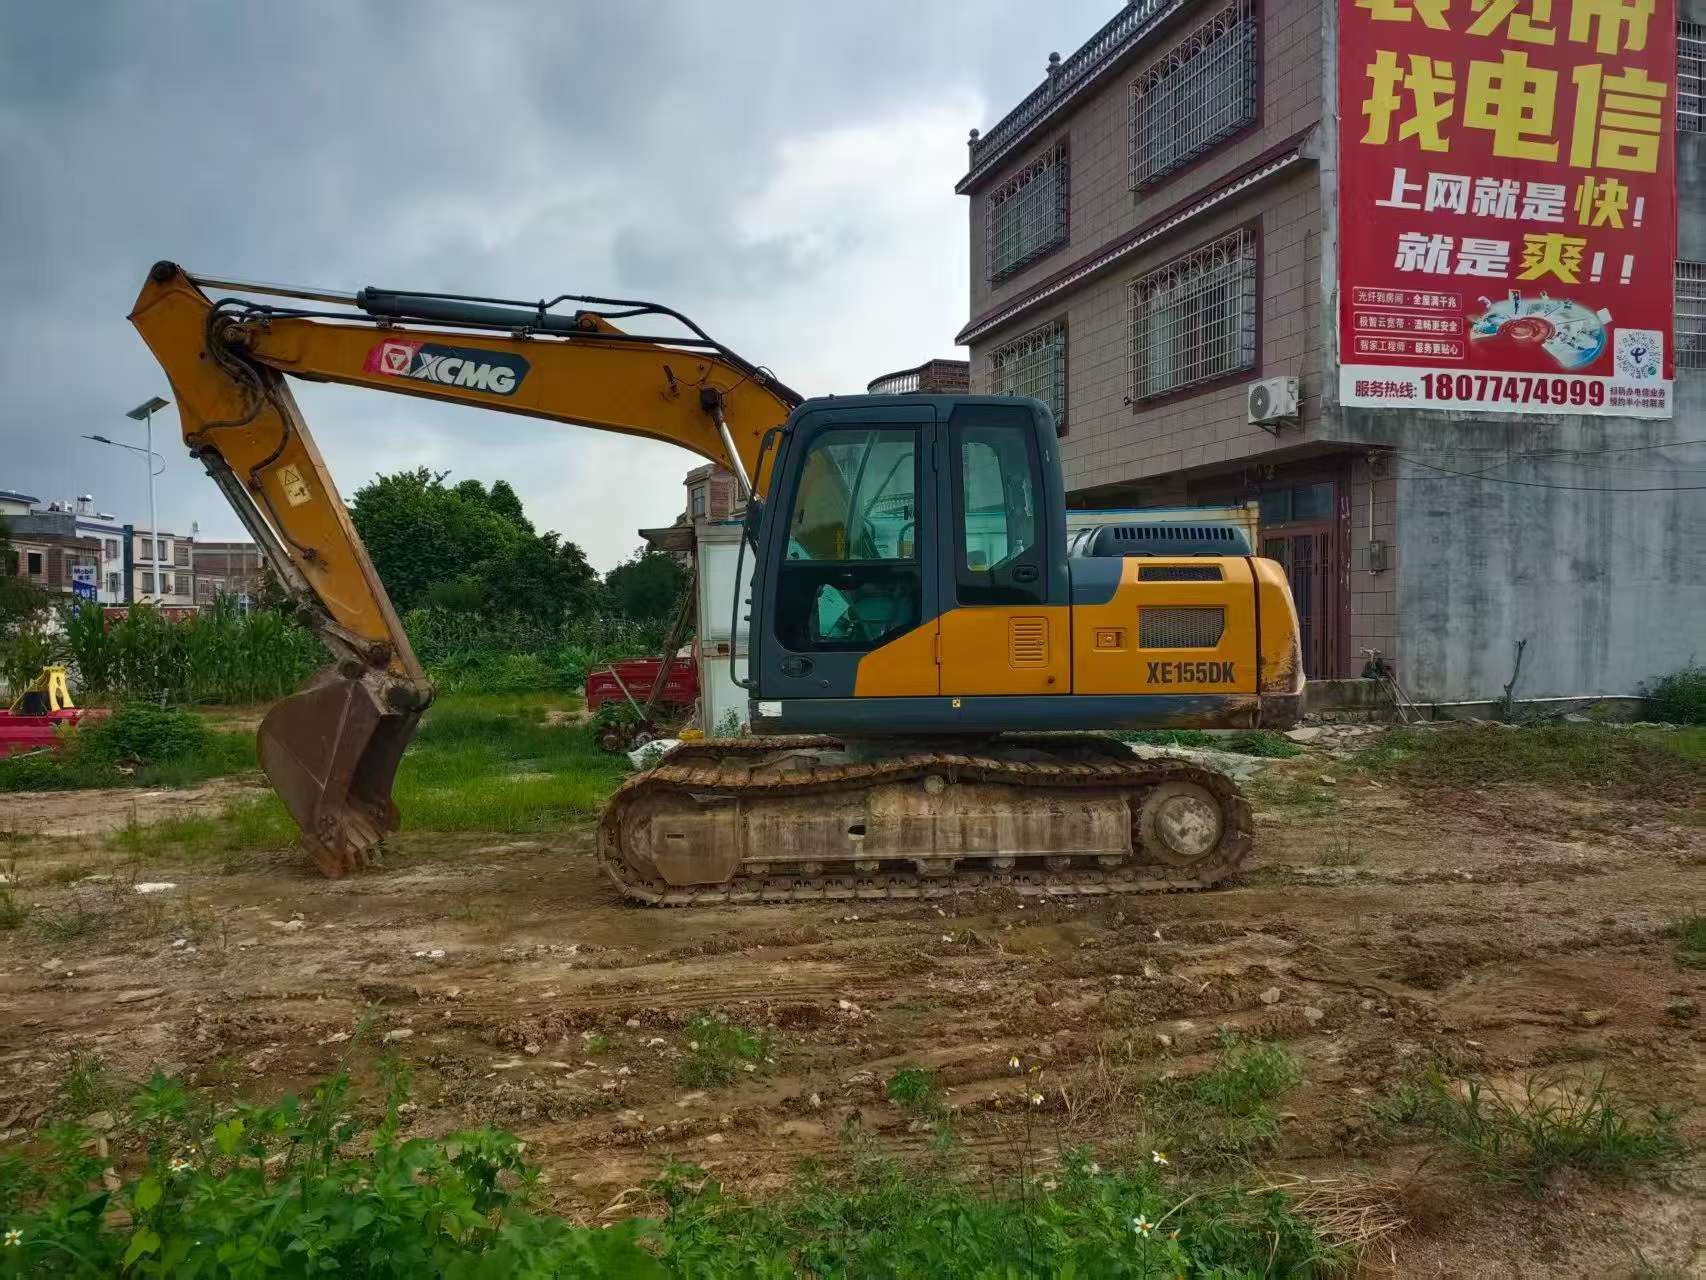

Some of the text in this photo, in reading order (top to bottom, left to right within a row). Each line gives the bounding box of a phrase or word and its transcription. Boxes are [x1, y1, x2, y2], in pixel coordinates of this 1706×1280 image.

[1360, 49, 1668, 173] 找电信
[410, 352, 516, 393] XCMG
[1420, 373, 1605, 407] 18077474999
[1146, 661, 1236, 684] XE155DK
